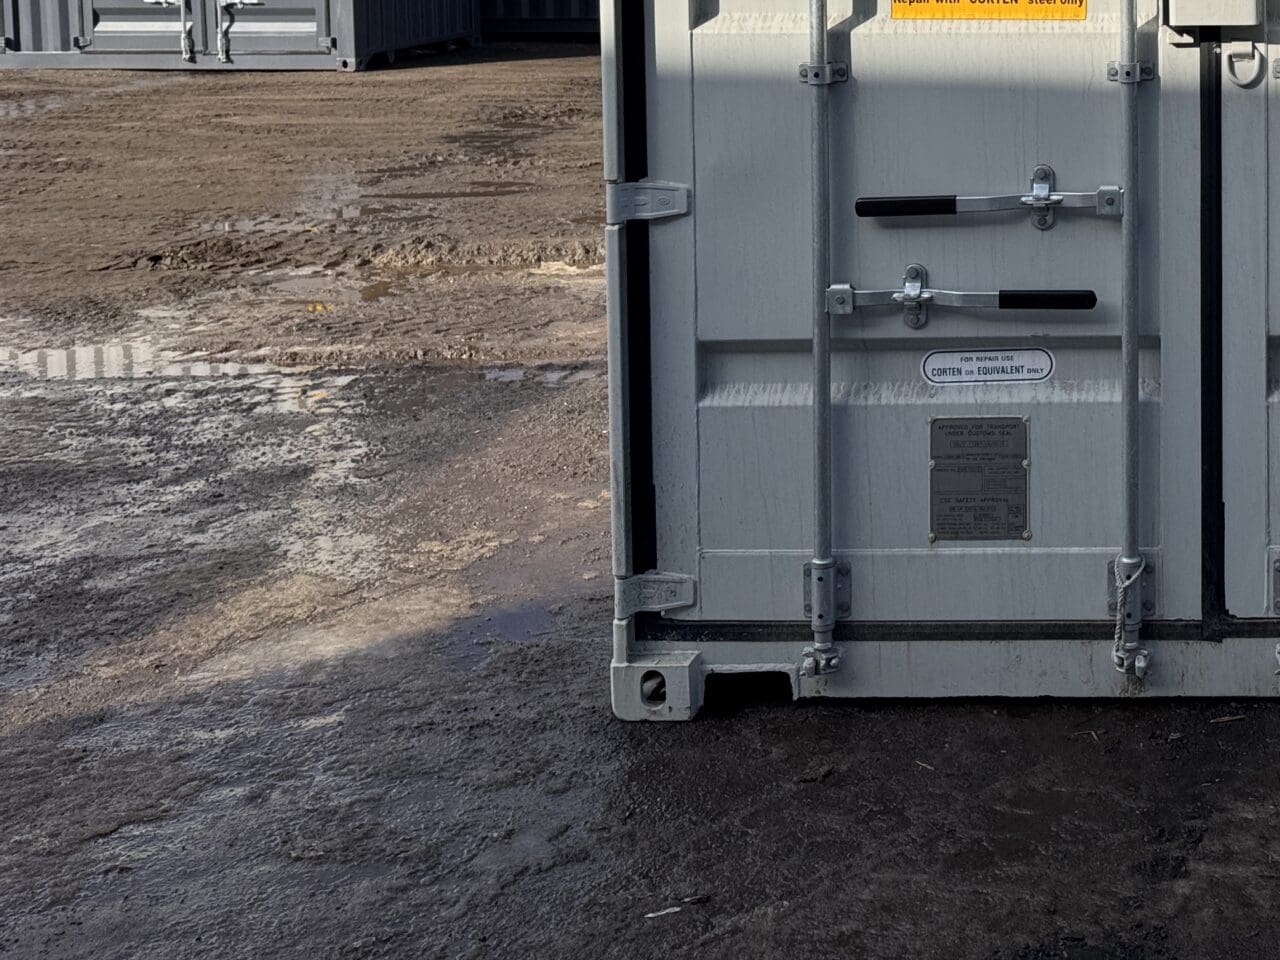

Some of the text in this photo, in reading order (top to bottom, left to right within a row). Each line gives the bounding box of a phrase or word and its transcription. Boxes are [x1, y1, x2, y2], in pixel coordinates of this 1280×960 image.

[931, 367, 962, 377] CORTEN
[977, 365, 1025, 376] EQUIVALENT
[1026, 367, 1045, 375] ONLY
